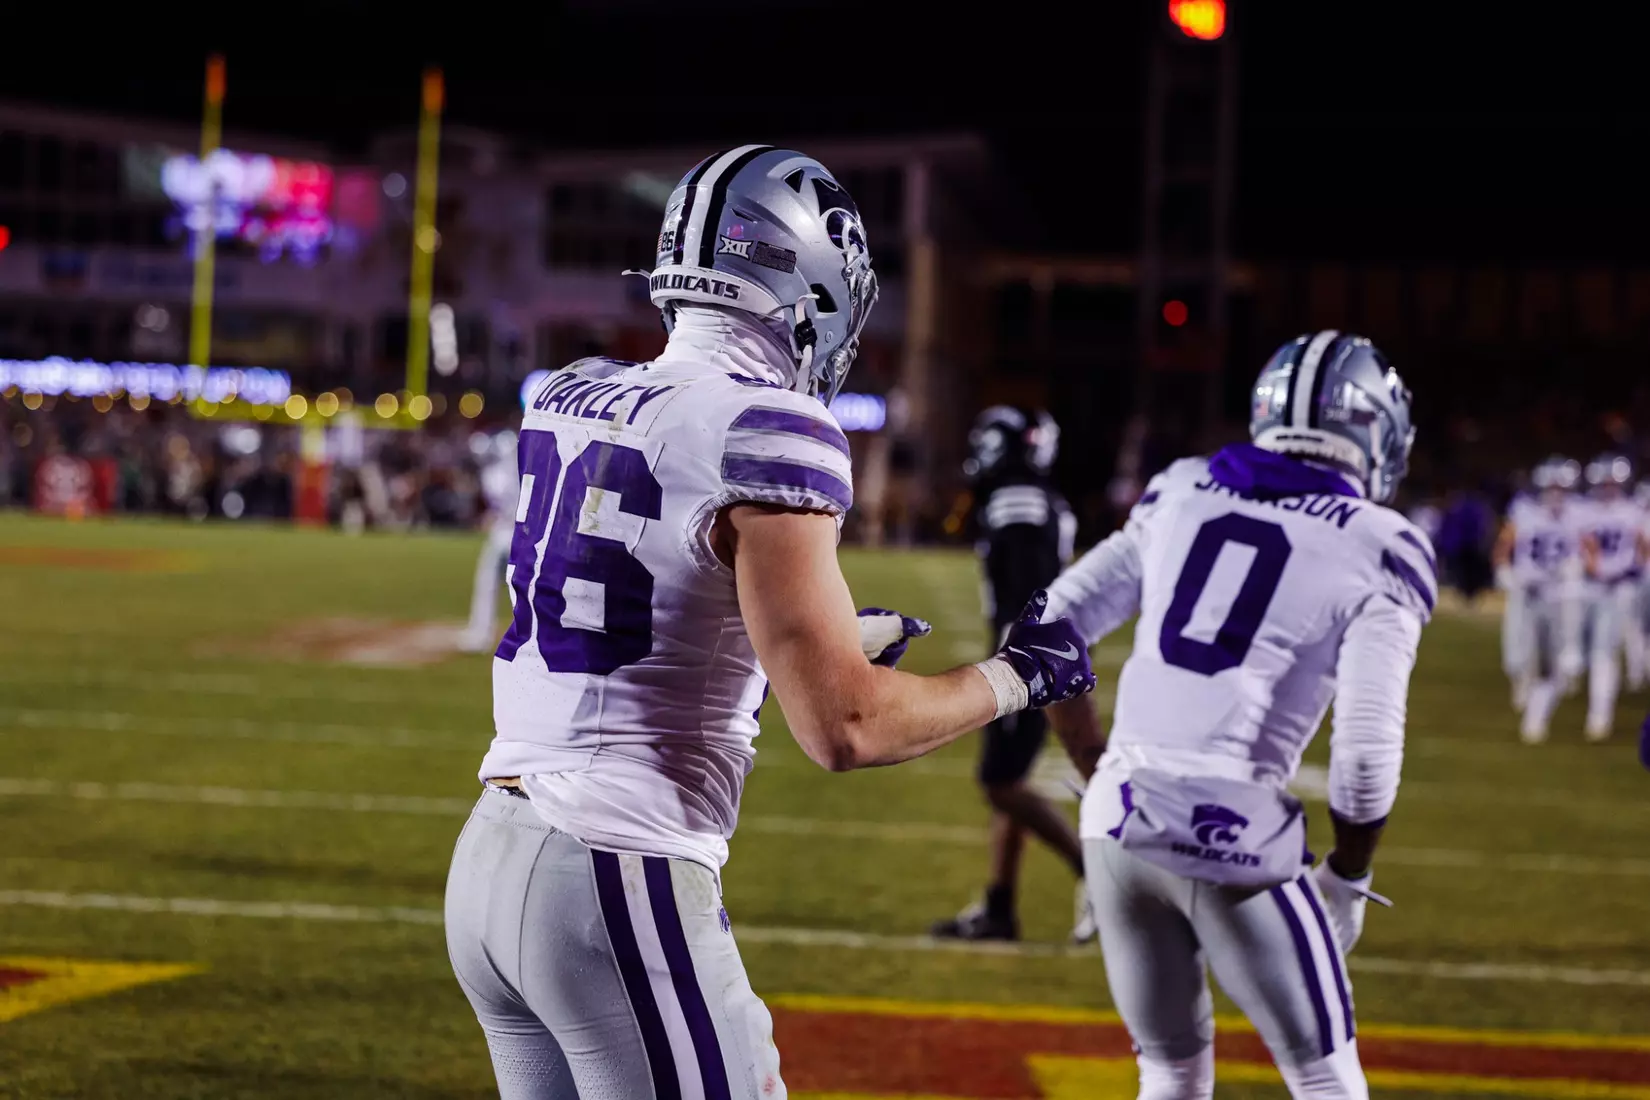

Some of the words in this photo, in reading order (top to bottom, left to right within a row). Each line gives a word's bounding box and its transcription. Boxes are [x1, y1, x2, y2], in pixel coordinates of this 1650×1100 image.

[718, 238, 752, 261] XII
[650, 274, 741, 300] WILDCATS
[533, 372, 675, 425] OAKLEY
[1159, 512, 1292, 677] 0
